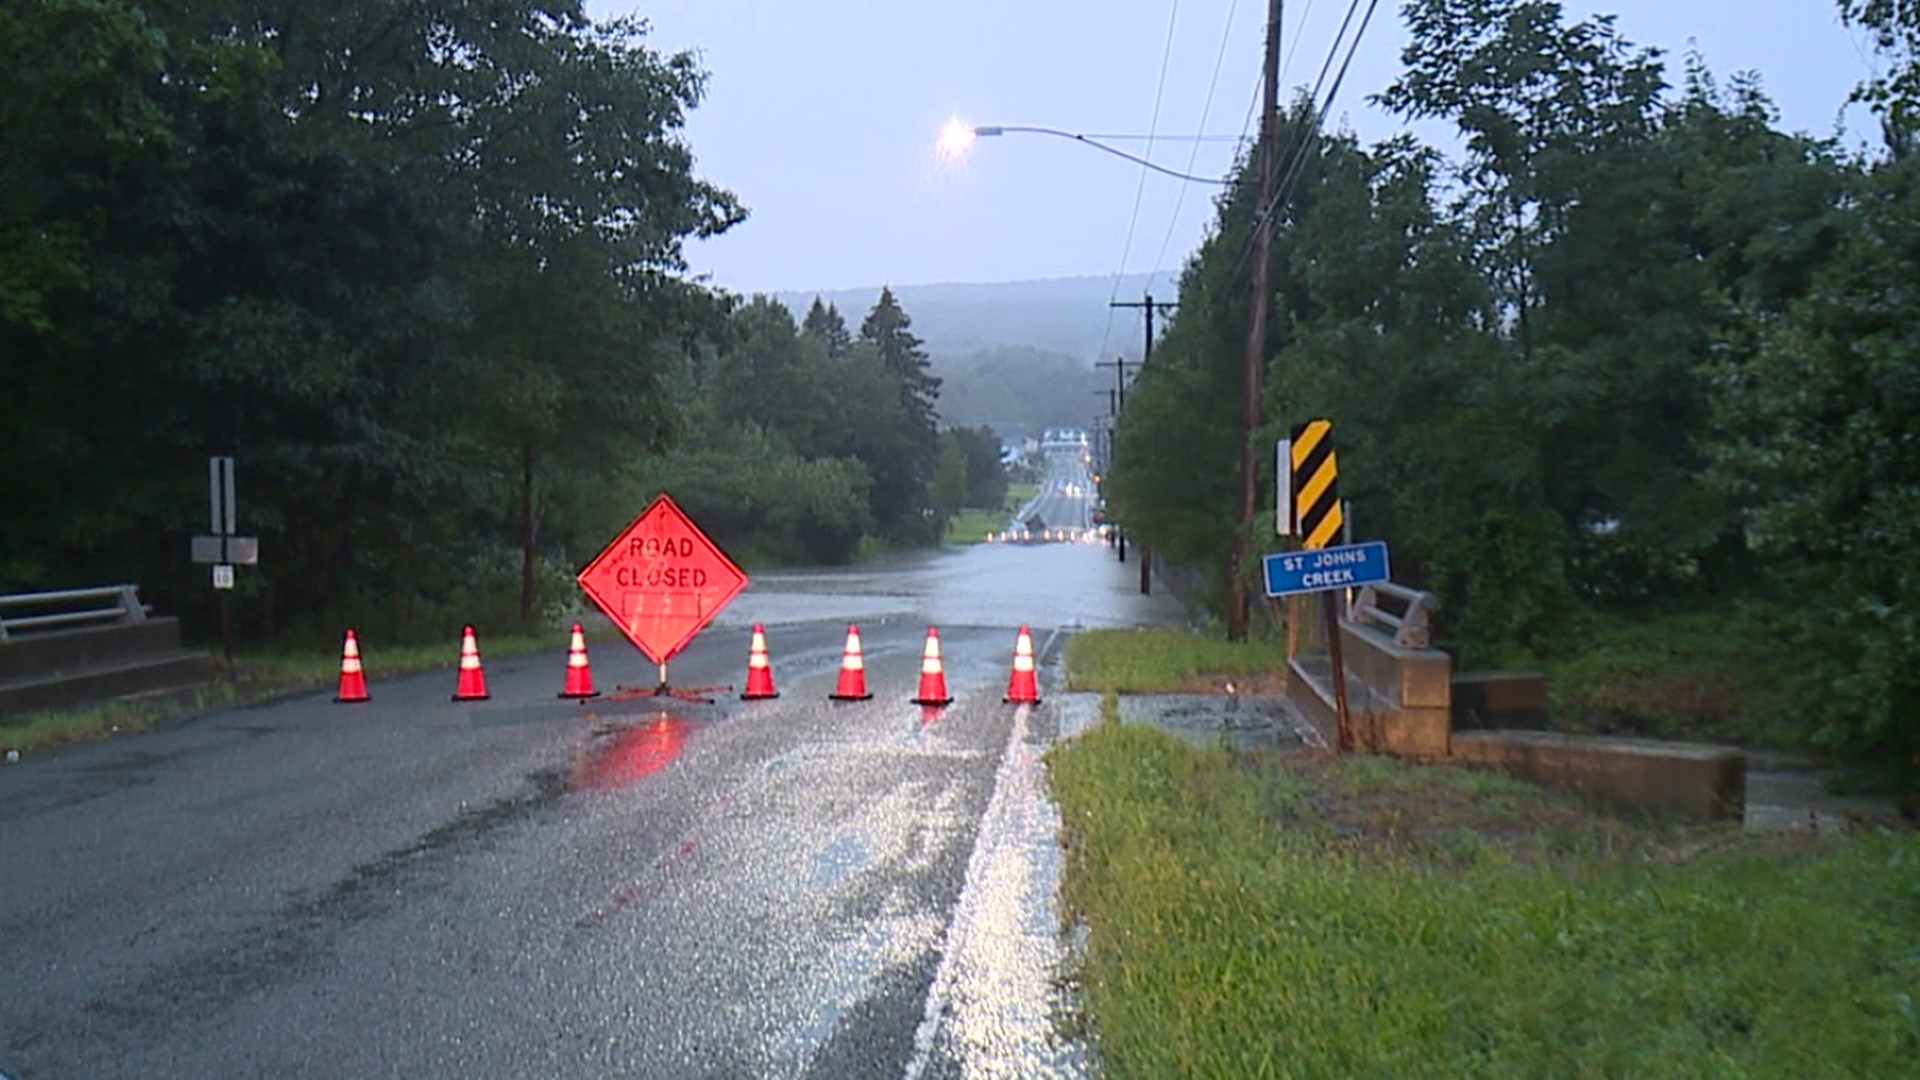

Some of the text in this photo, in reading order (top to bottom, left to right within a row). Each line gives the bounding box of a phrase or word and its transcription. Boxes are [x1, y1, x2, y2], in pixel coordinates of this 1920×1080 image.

[630, 538, 693, 557] ROAD
[1284, 549, 1366, 571] ST JOHNS
[617, 568, 706, 587] CLOSED
[1302, 568, 1354, 587] CREEK
